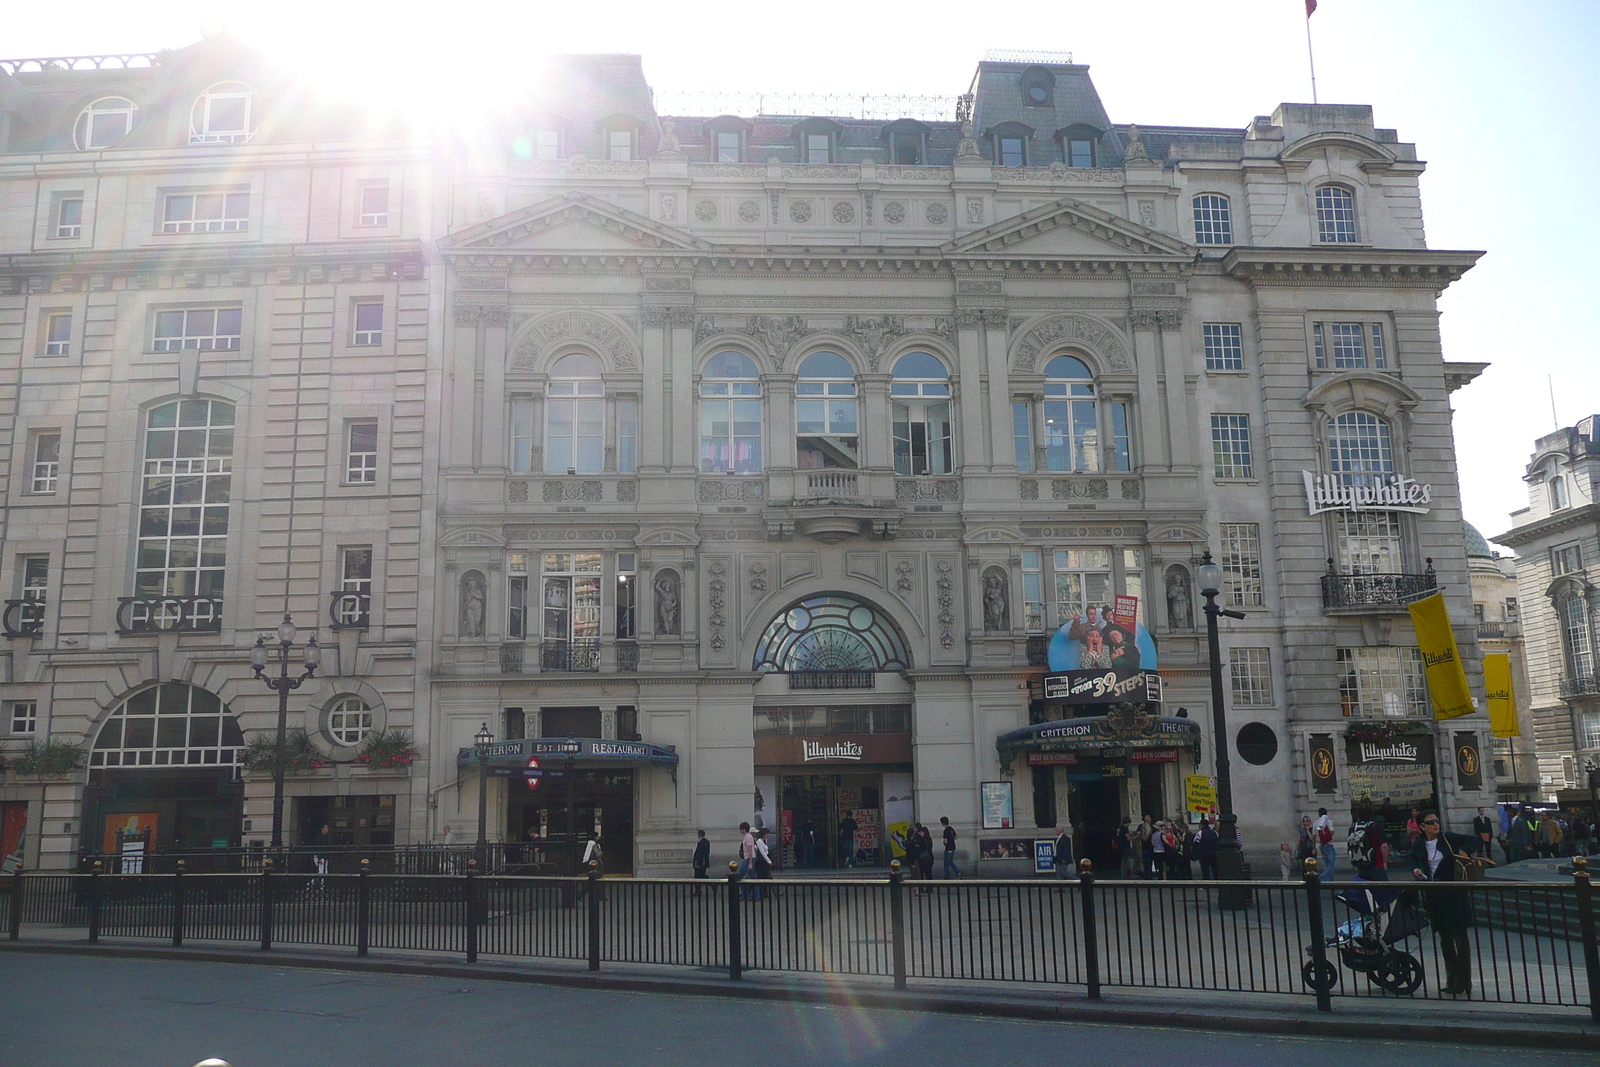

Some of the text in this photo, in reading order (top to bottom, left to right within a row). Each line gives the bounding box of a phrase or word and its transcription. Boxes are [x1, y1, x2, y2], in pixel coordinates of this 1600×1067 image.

[1302, 469, 1432, 516] Lillywhites
[1093, 671, 1117, 698] 39
[1041, 722, 1191, 738] CRITERION THEATRE
[592, 743, 646, 755] RESTAURANT
[802, 739, 863, 762] Lillywhites
[1360, 742, 1418, 763] Lillywhites
[860, 840, 874, 848] GO!
[1038, 846, 1052, 856] AIR
